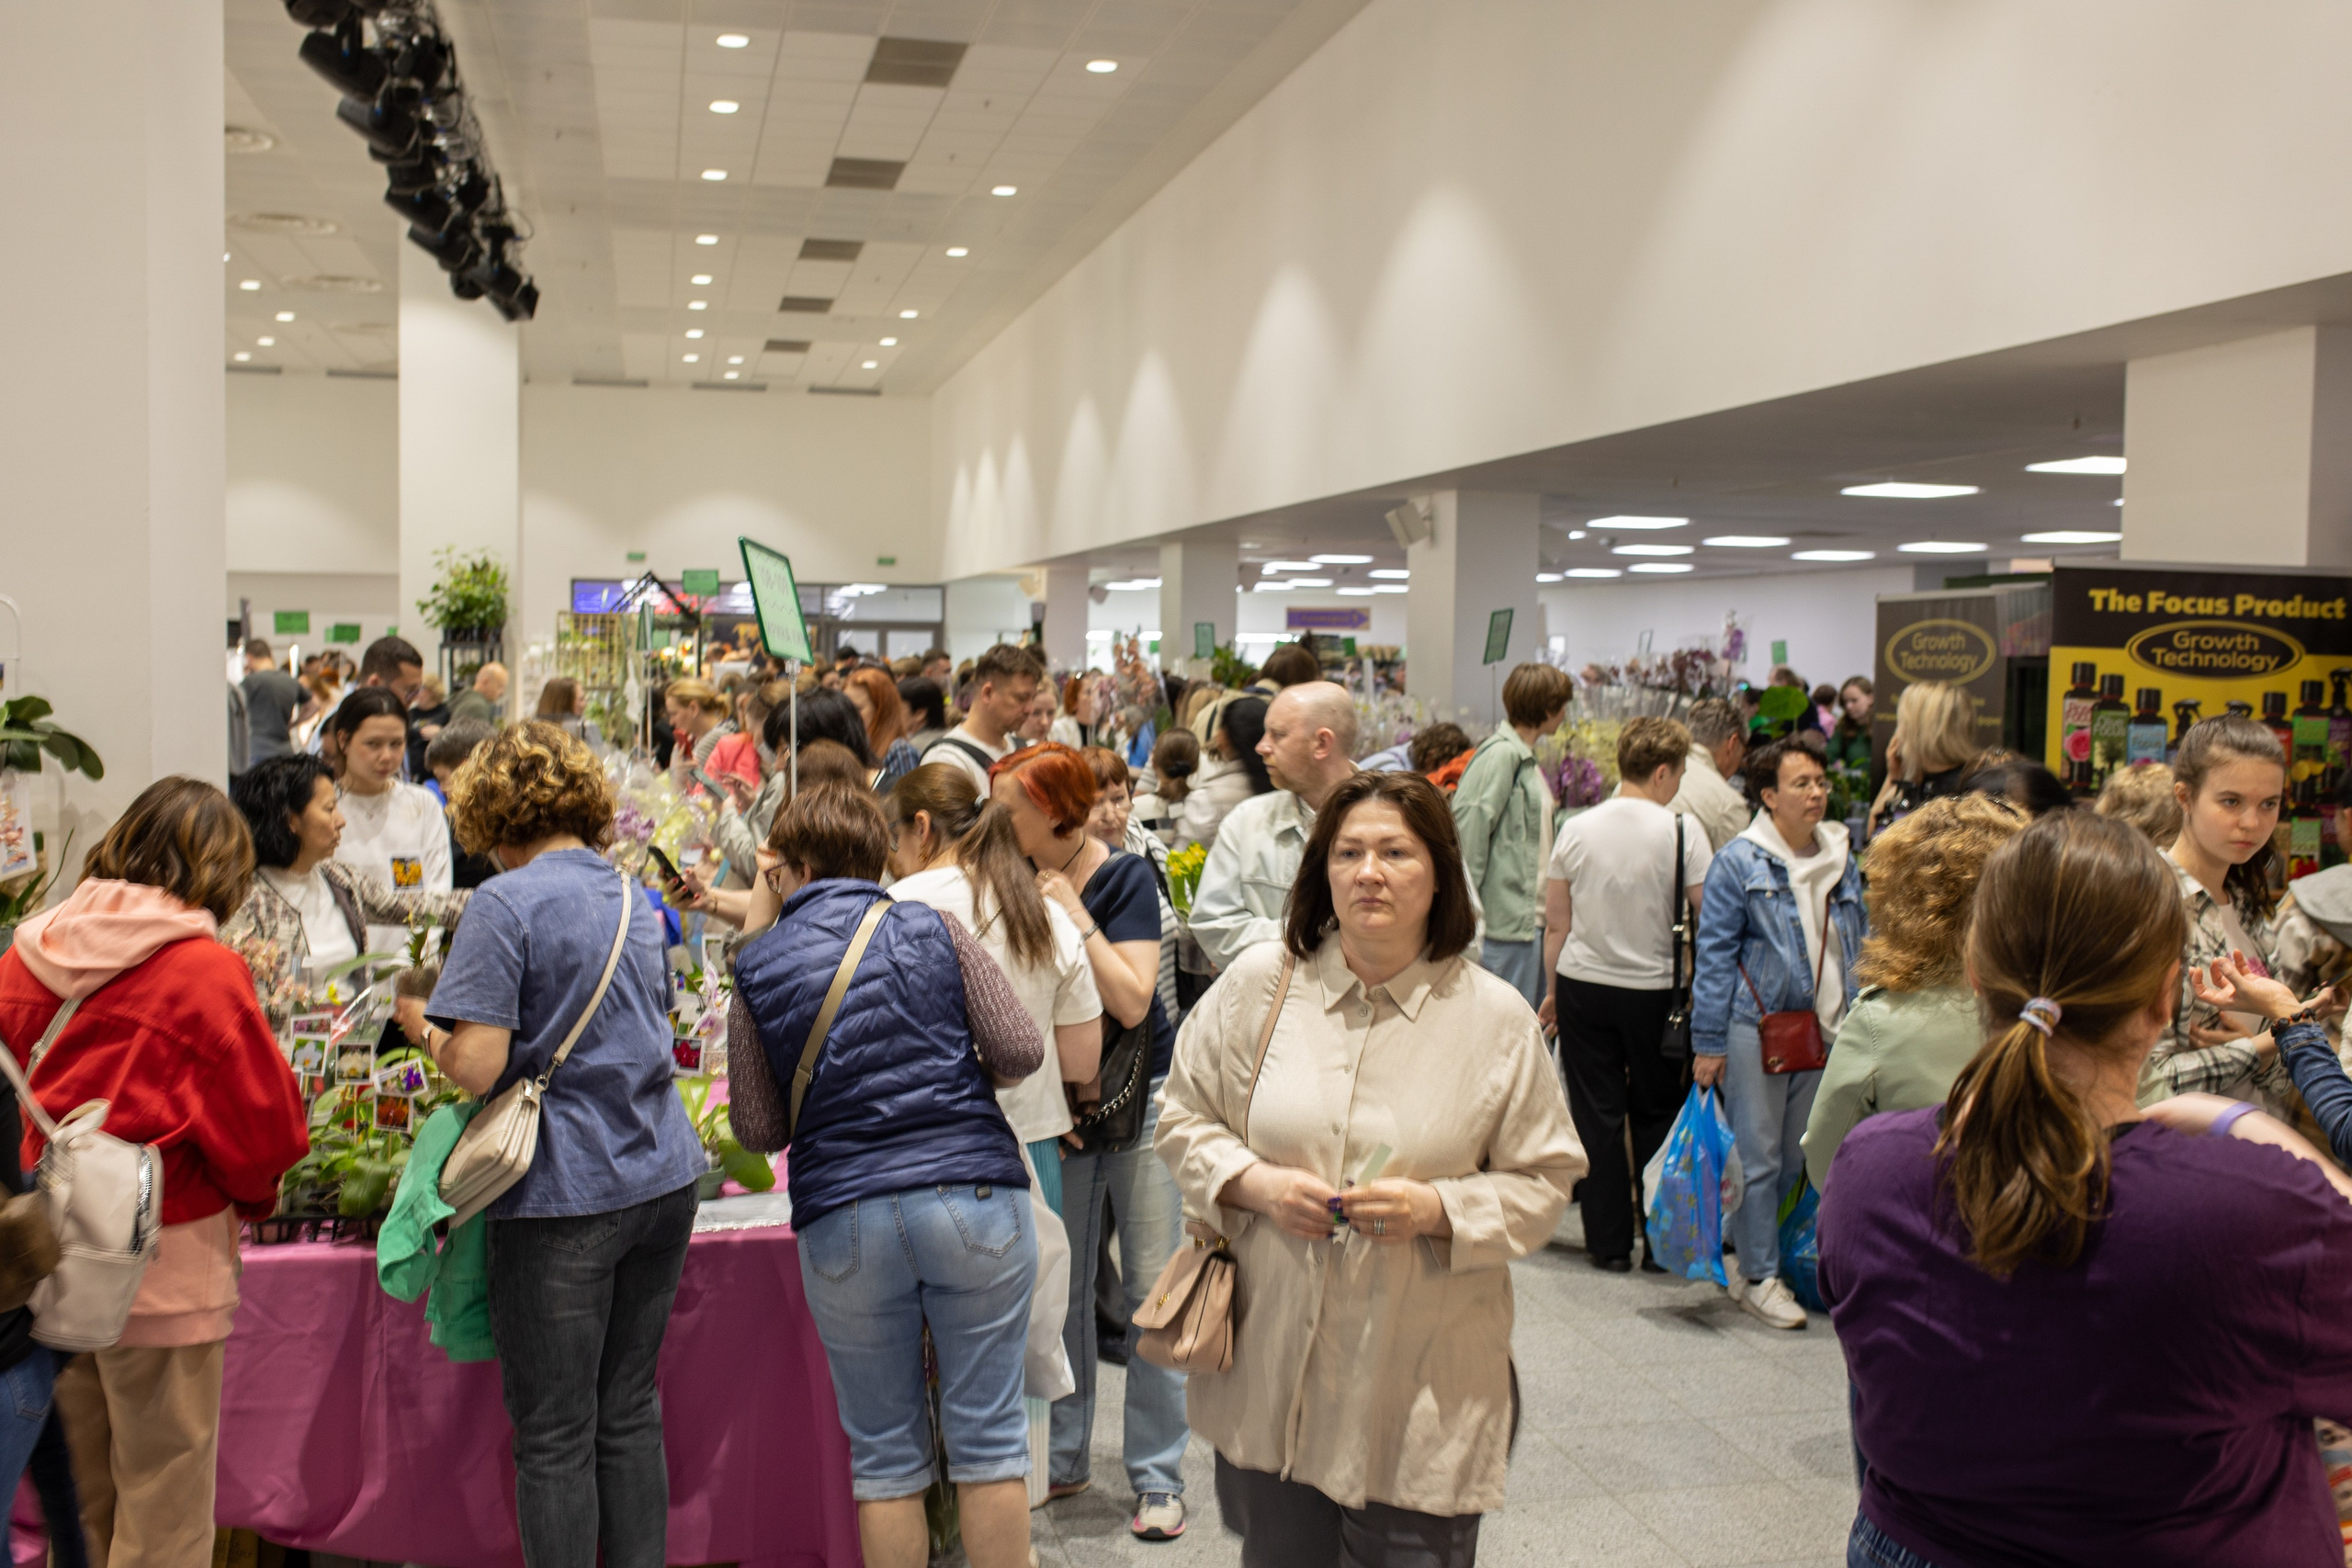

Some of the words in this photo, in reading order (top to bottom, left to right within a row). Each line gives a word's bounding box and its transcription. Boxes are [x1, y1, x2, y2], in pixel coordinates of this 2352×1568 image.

[2088, 588, 2143, 614] The
[2146, 591, 2230, 616] Focus
[2234, 593, 2347, 620] Product
[1912, 632, 1966, 651] Growth
[2172, 630, 2260, 652] Growth
[1898, 650, 1979, 673] Technology
[2151, 648, 2280, 672] Technology
